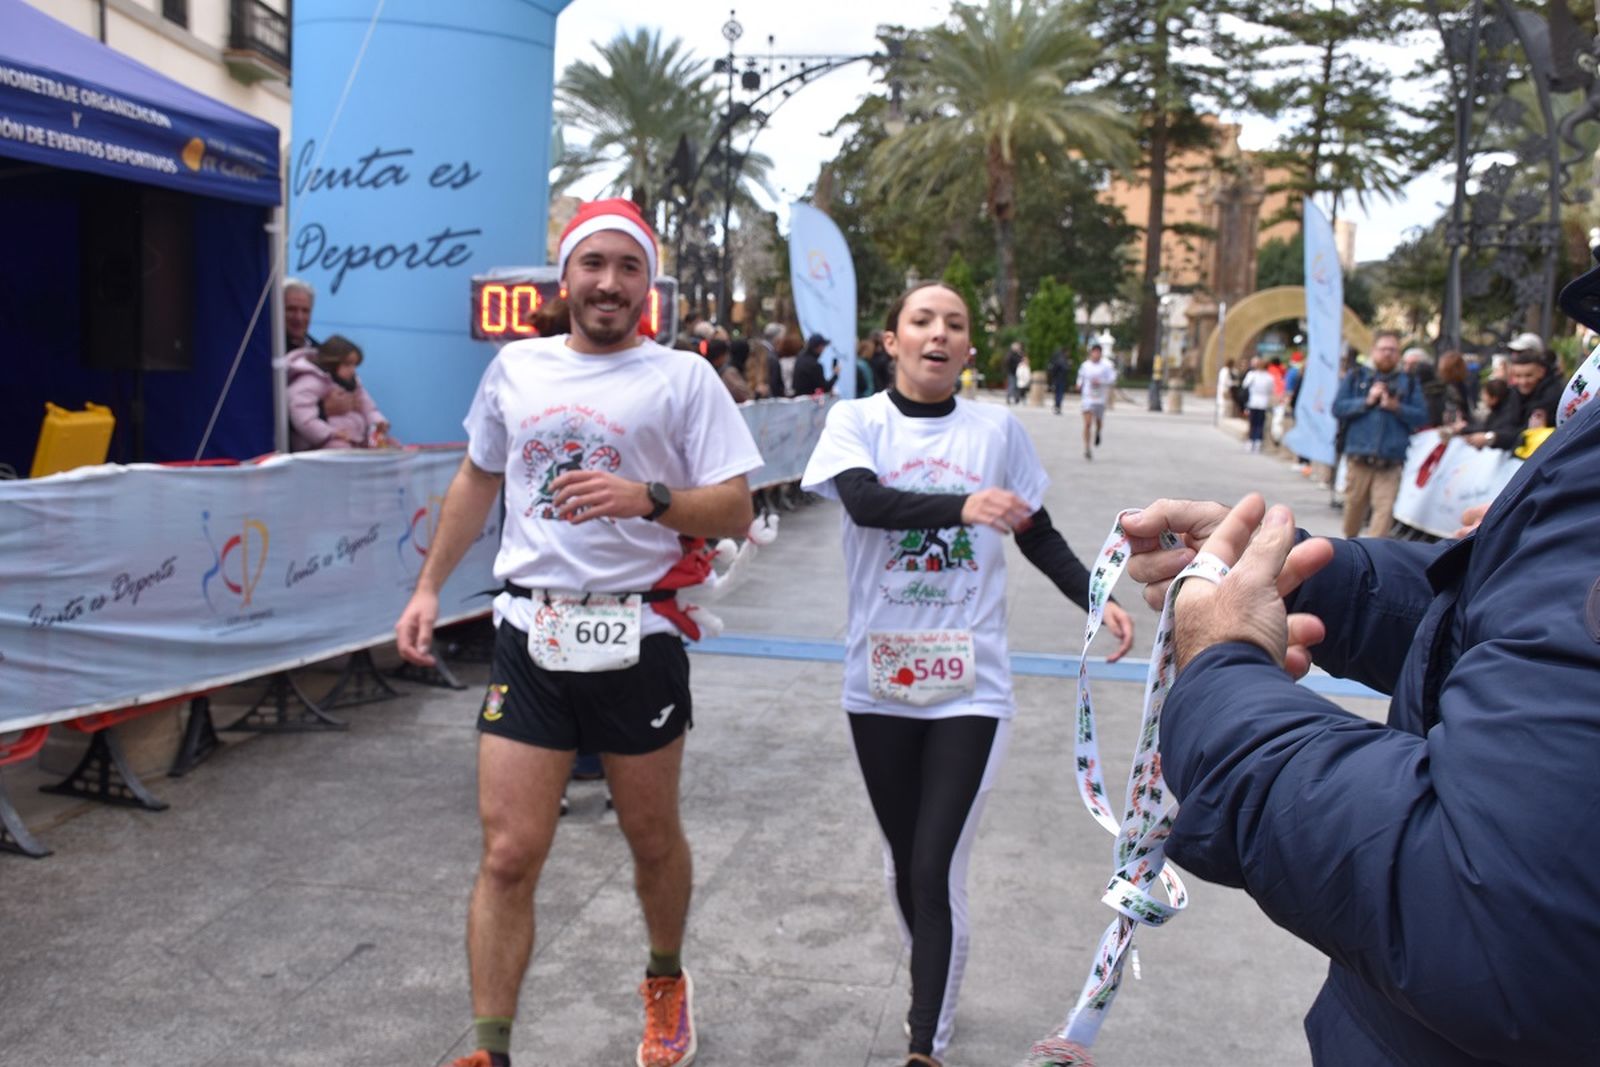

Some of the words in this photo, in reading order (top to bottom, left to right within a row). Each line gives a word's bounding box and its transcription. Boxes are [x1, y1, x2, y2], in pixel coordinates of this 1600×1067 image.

[71, 110, 82, 129] Y
[25, 124, 46, 146] DE
[46, 129, 105, 159] EVENTOS
[105, 142, 178, 175] DEPORTIVOS
[428, 162, 480, 190] es
[295, 222, 482, 295] Deporte
[575, 620, 628, 645] 602
[914, 657, 964, 681] 549
